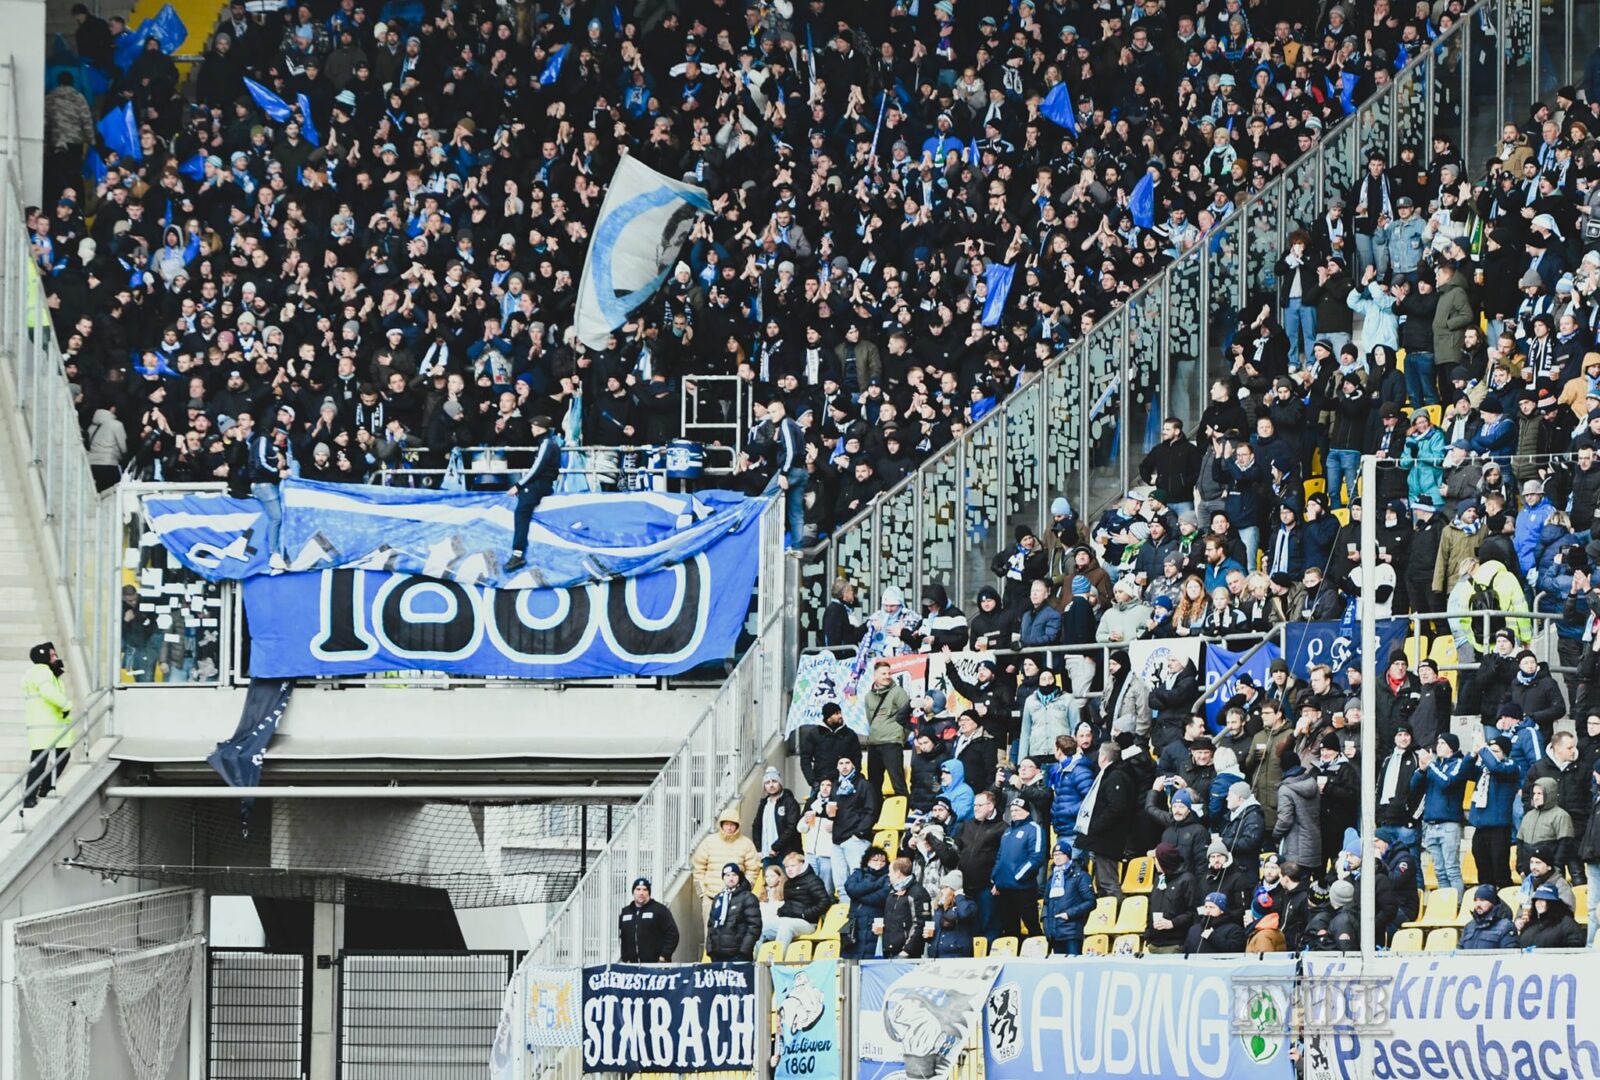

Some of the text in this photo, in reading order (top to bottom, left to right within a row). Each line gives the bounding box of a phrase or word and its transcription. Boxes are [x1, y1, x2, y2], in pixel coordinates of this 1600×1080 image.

[308, 554, 711, 664] 1860
[588, 971, 681, 991] GRENZSTADT
[693, 969, 747, 988] LÖWEN
[584, 994, 755, 1068] SIMBACH
[1030, 970, 1230, 1078] AUBING
[1333, 1024, 1600, 1080] Pasenbach
[785, 1055, 816, 1075] 1860
